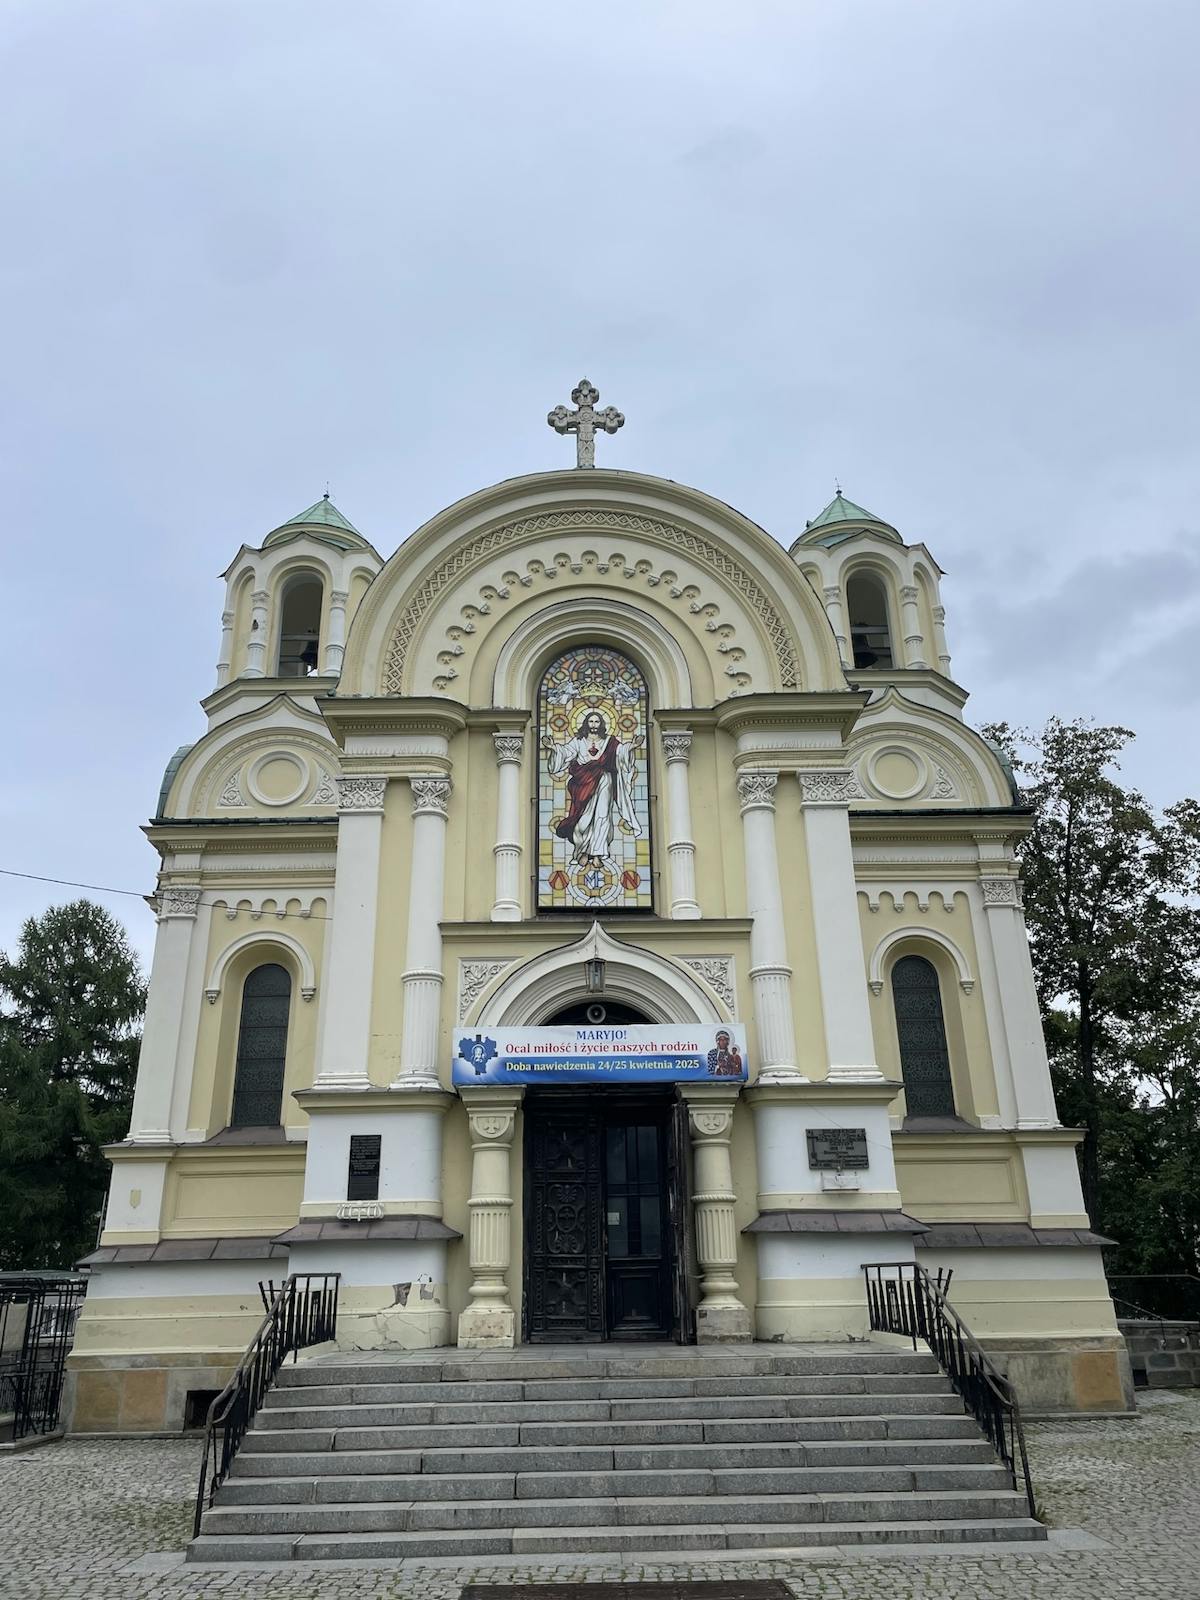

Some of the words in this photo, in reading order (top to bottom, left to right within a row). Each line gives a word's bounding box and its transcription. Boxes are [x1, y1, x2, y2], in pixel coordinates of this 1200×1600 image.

[576, 1030, 627, 1041] MARYJO!
[505, 1043, 530, 1053] Ocal
[534, 1042, 571, 1053] miłość
[574, 1042, 578, 1052] i
[581, 1042, 609, 1055] życie
[613, 1041, 657, 1055] naszych
[661, 1041, 698, 1052] rodzin
[506, 1062, 531, 1071] Doba
[534, 1061, 595, 1071] nawiedzenia
[598, 1060, 627, 1072] 24/25
[629, 1060, 673, 1070] kwietnia
[675, 1059, 700, 1069] 2025
